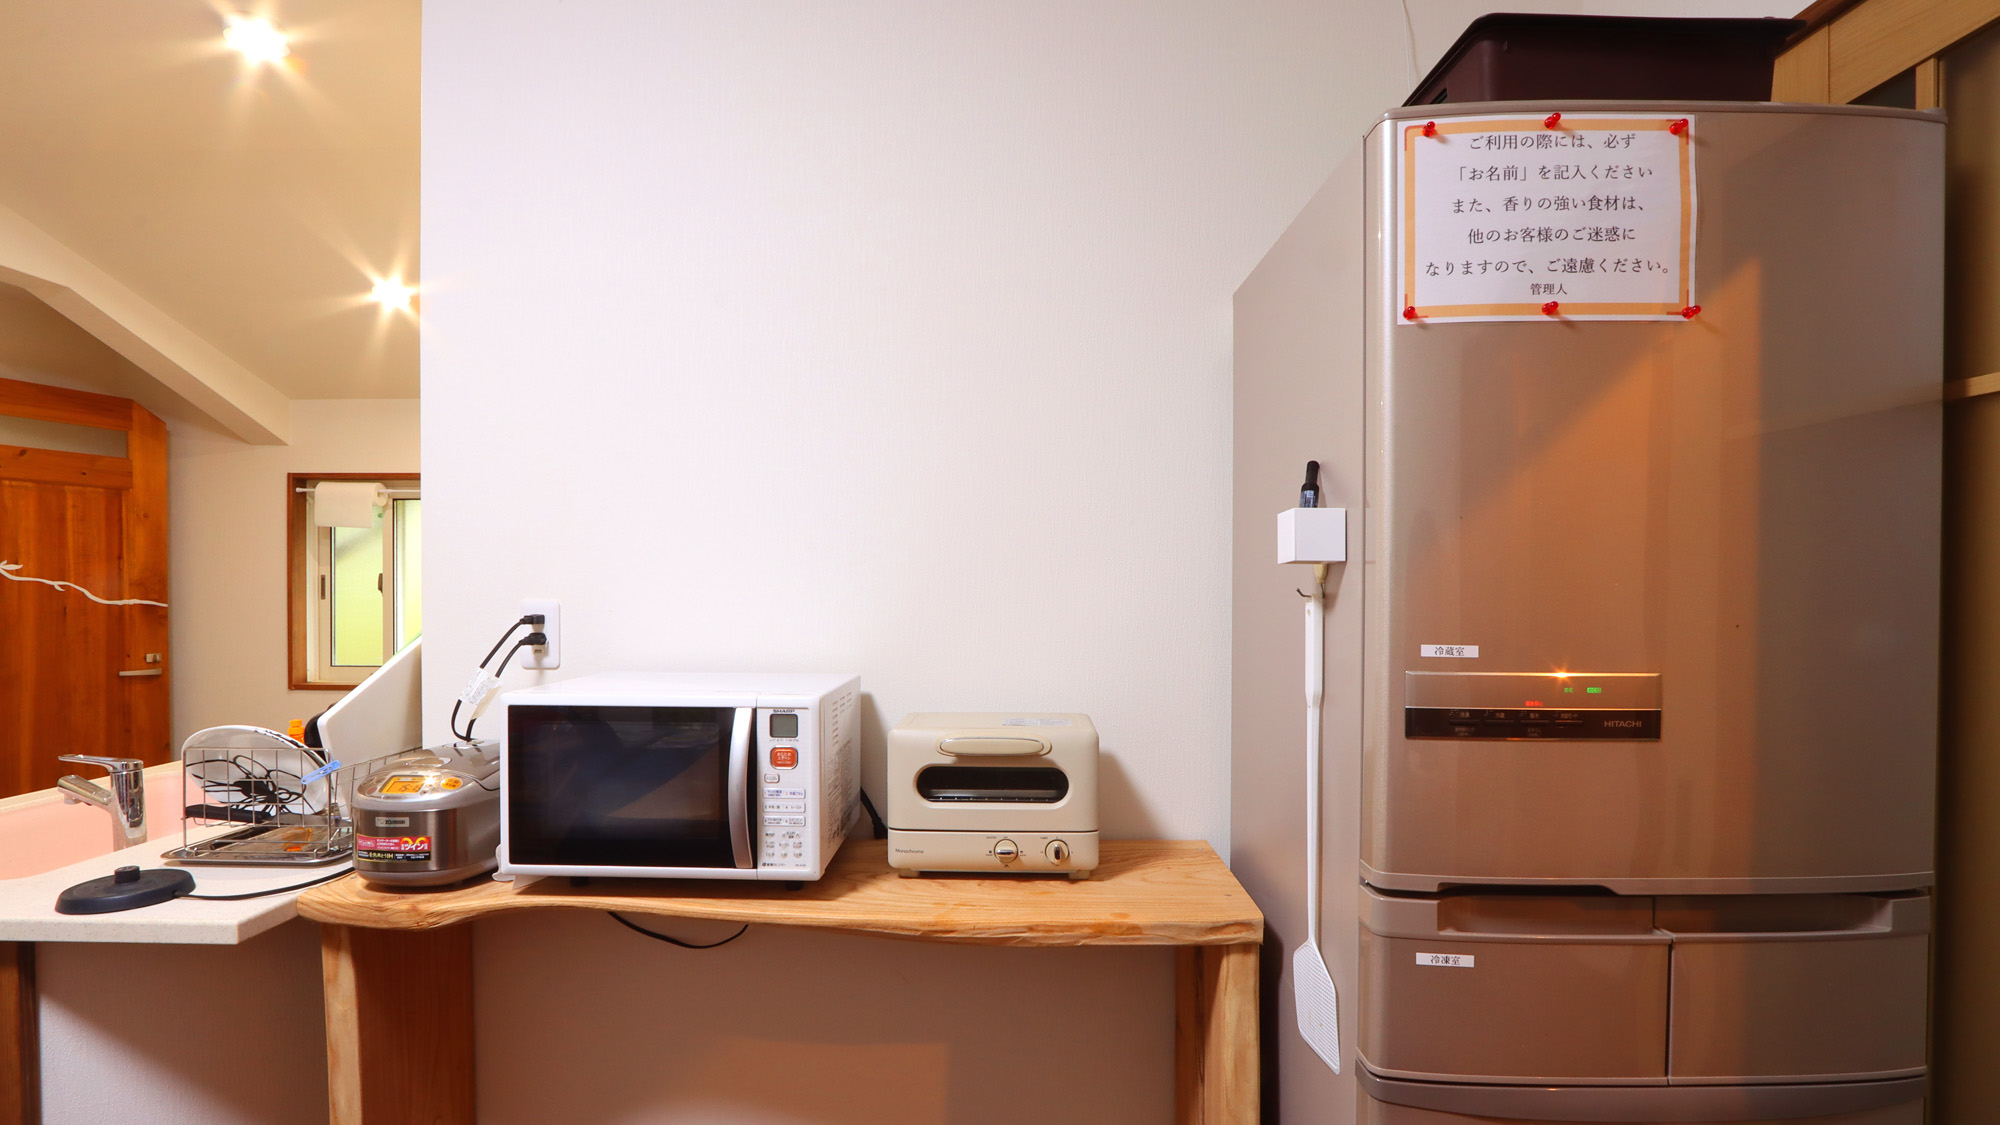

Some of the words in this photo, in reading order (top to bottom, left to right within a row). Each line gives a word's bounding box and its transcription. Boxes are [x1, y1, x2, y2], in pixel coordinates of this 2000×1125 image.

[1469, 133, 1637, 150] ご利用の際には、必ず
[1458, 164, 1653, 182] 「お名前」を記入ください
[1451, 195, 1645, 214] また、香りの強い食材は、
[1467, 226, 1636, 245] 他のお客様のご迷惑に
[1425, 258, 1669, 277] なりますので、ご遠慮ください。
[1530, 283, 1568, 296] 管理人
[1433, 645, 1465, 657] 冷蔵室
[1604, 720, 1642, 728] HITACHI
[1430, 955, 1461, 965] 冷凍室
